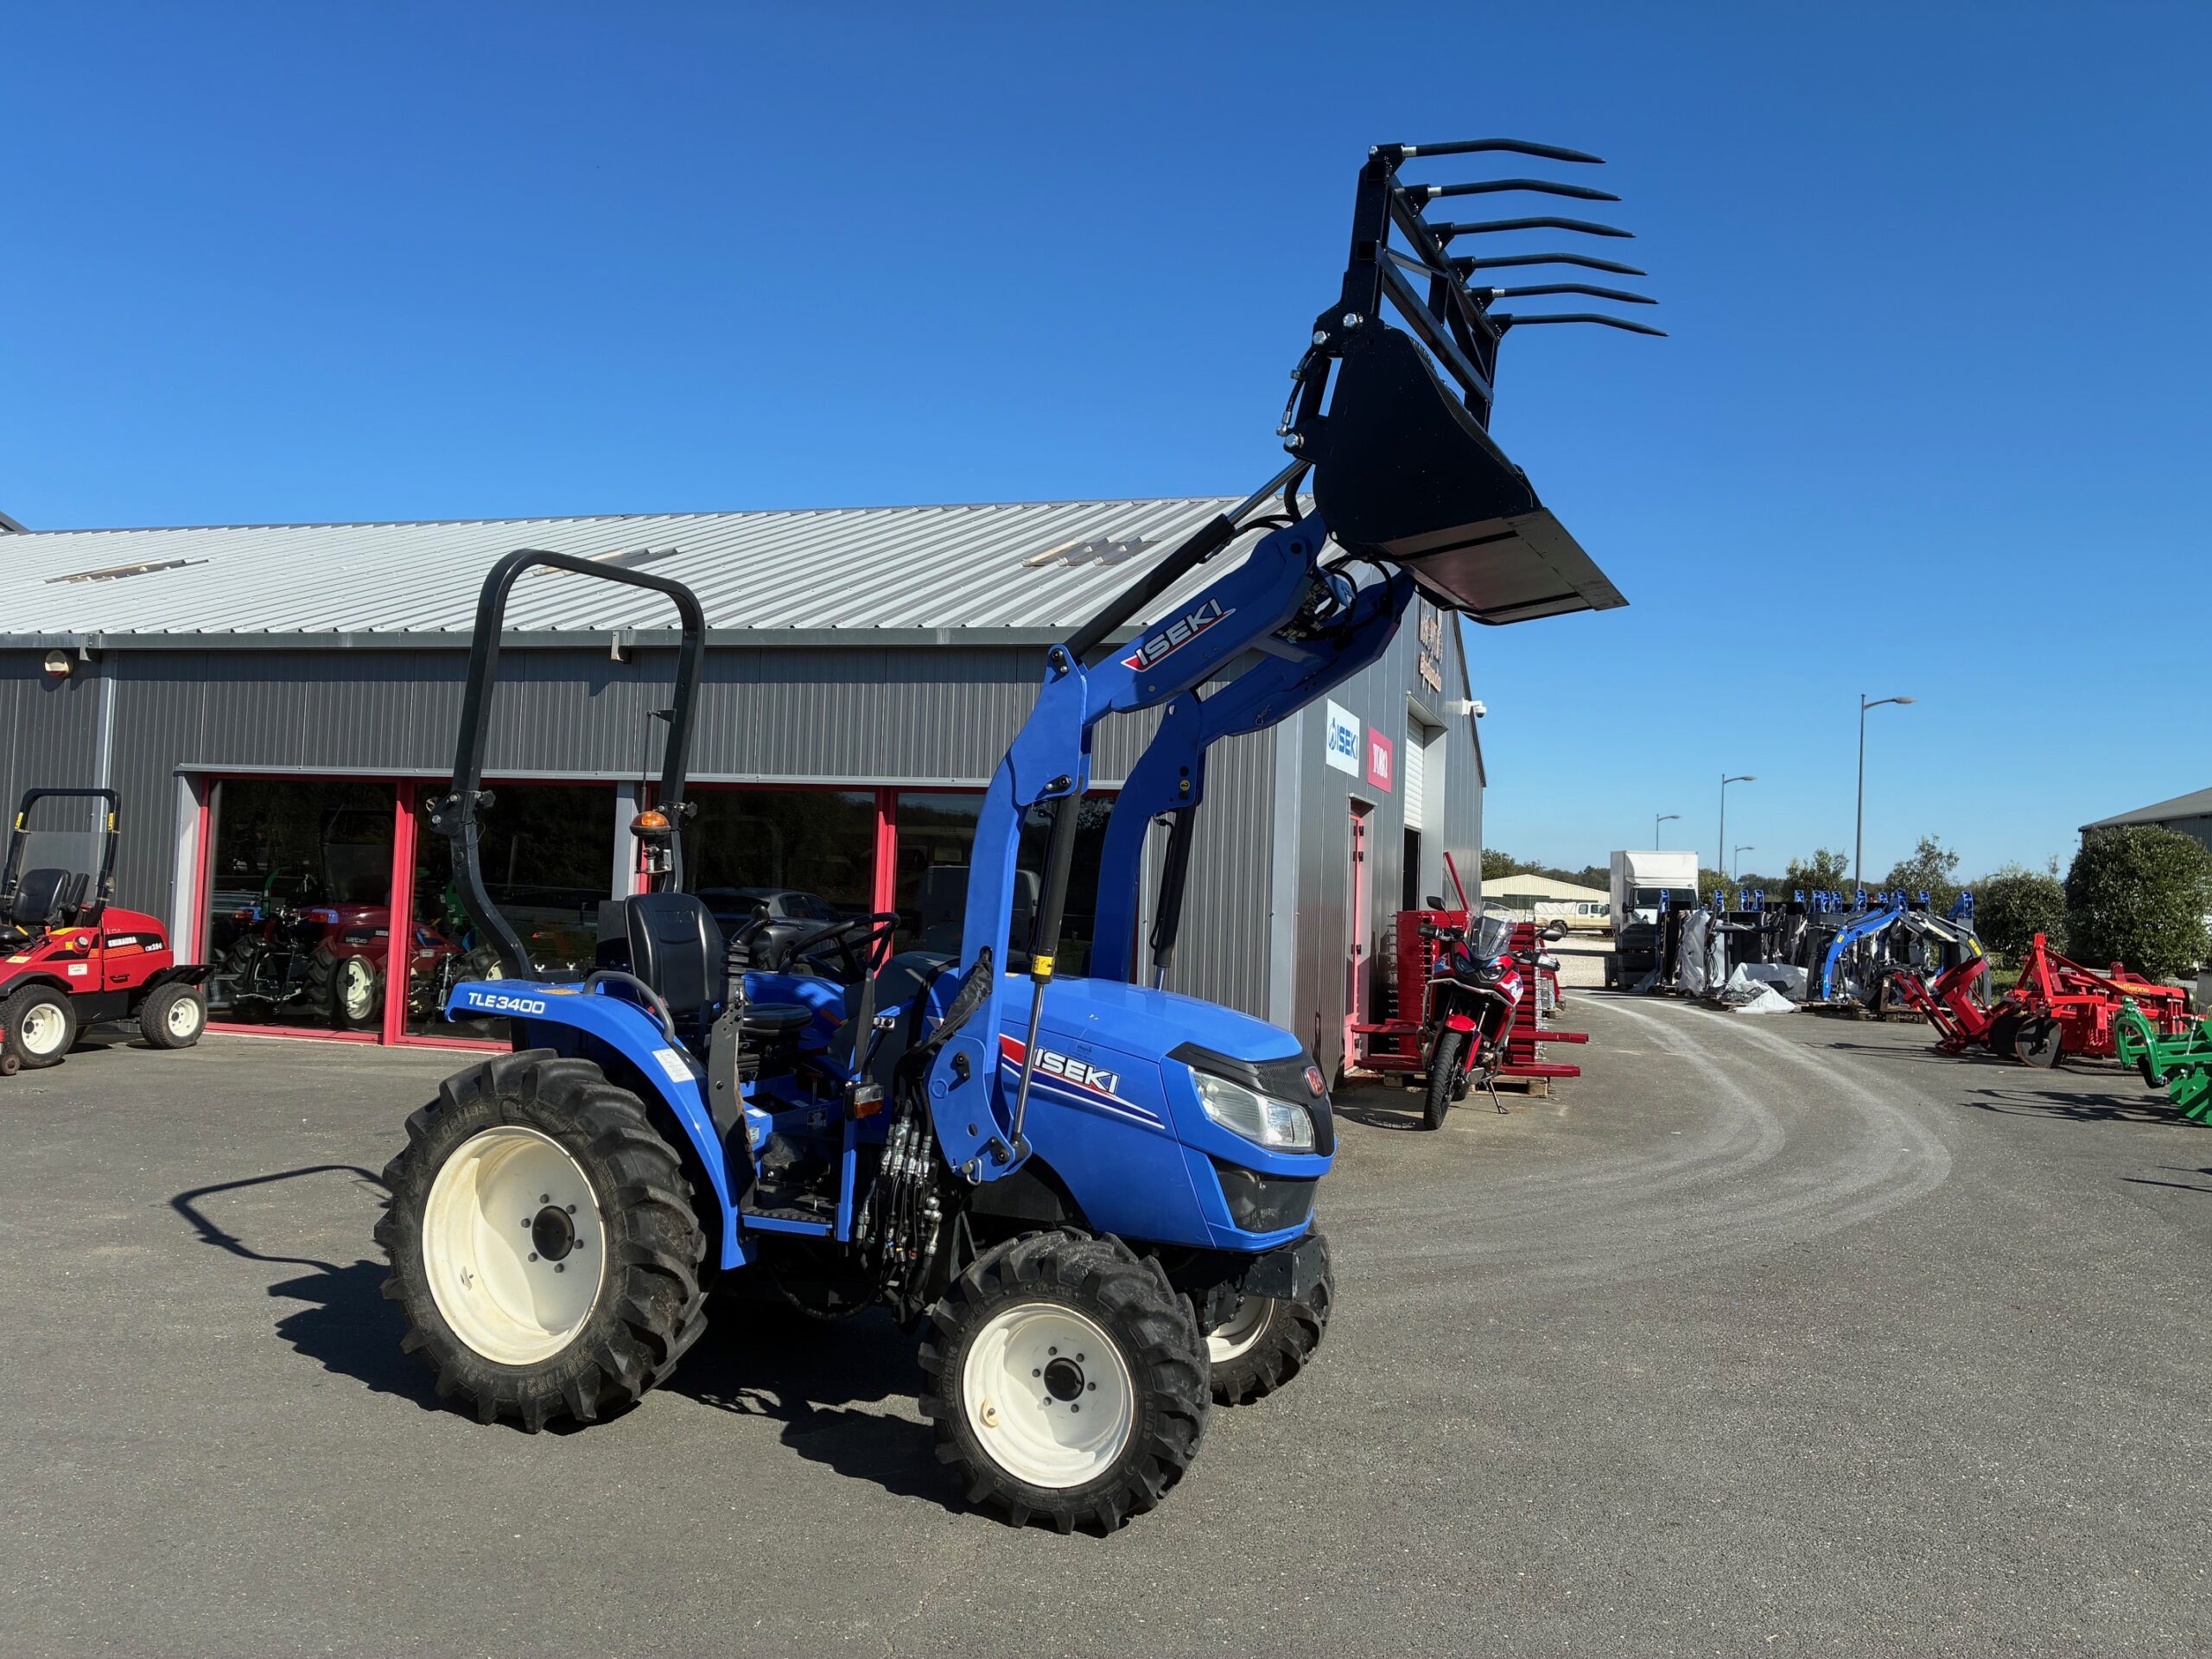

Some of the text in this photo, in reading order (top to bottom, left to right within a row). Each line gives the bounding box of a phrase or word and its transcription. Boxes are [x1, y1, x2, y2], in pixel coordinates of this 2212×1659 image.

[1135, 597, 1224, 666] ISEKI
[1336, 724, 1358, 760] ISEKI
[468, 992, 545, 1014] TLE3400
[1034, 1046, 1119, 1096] ISEKI
